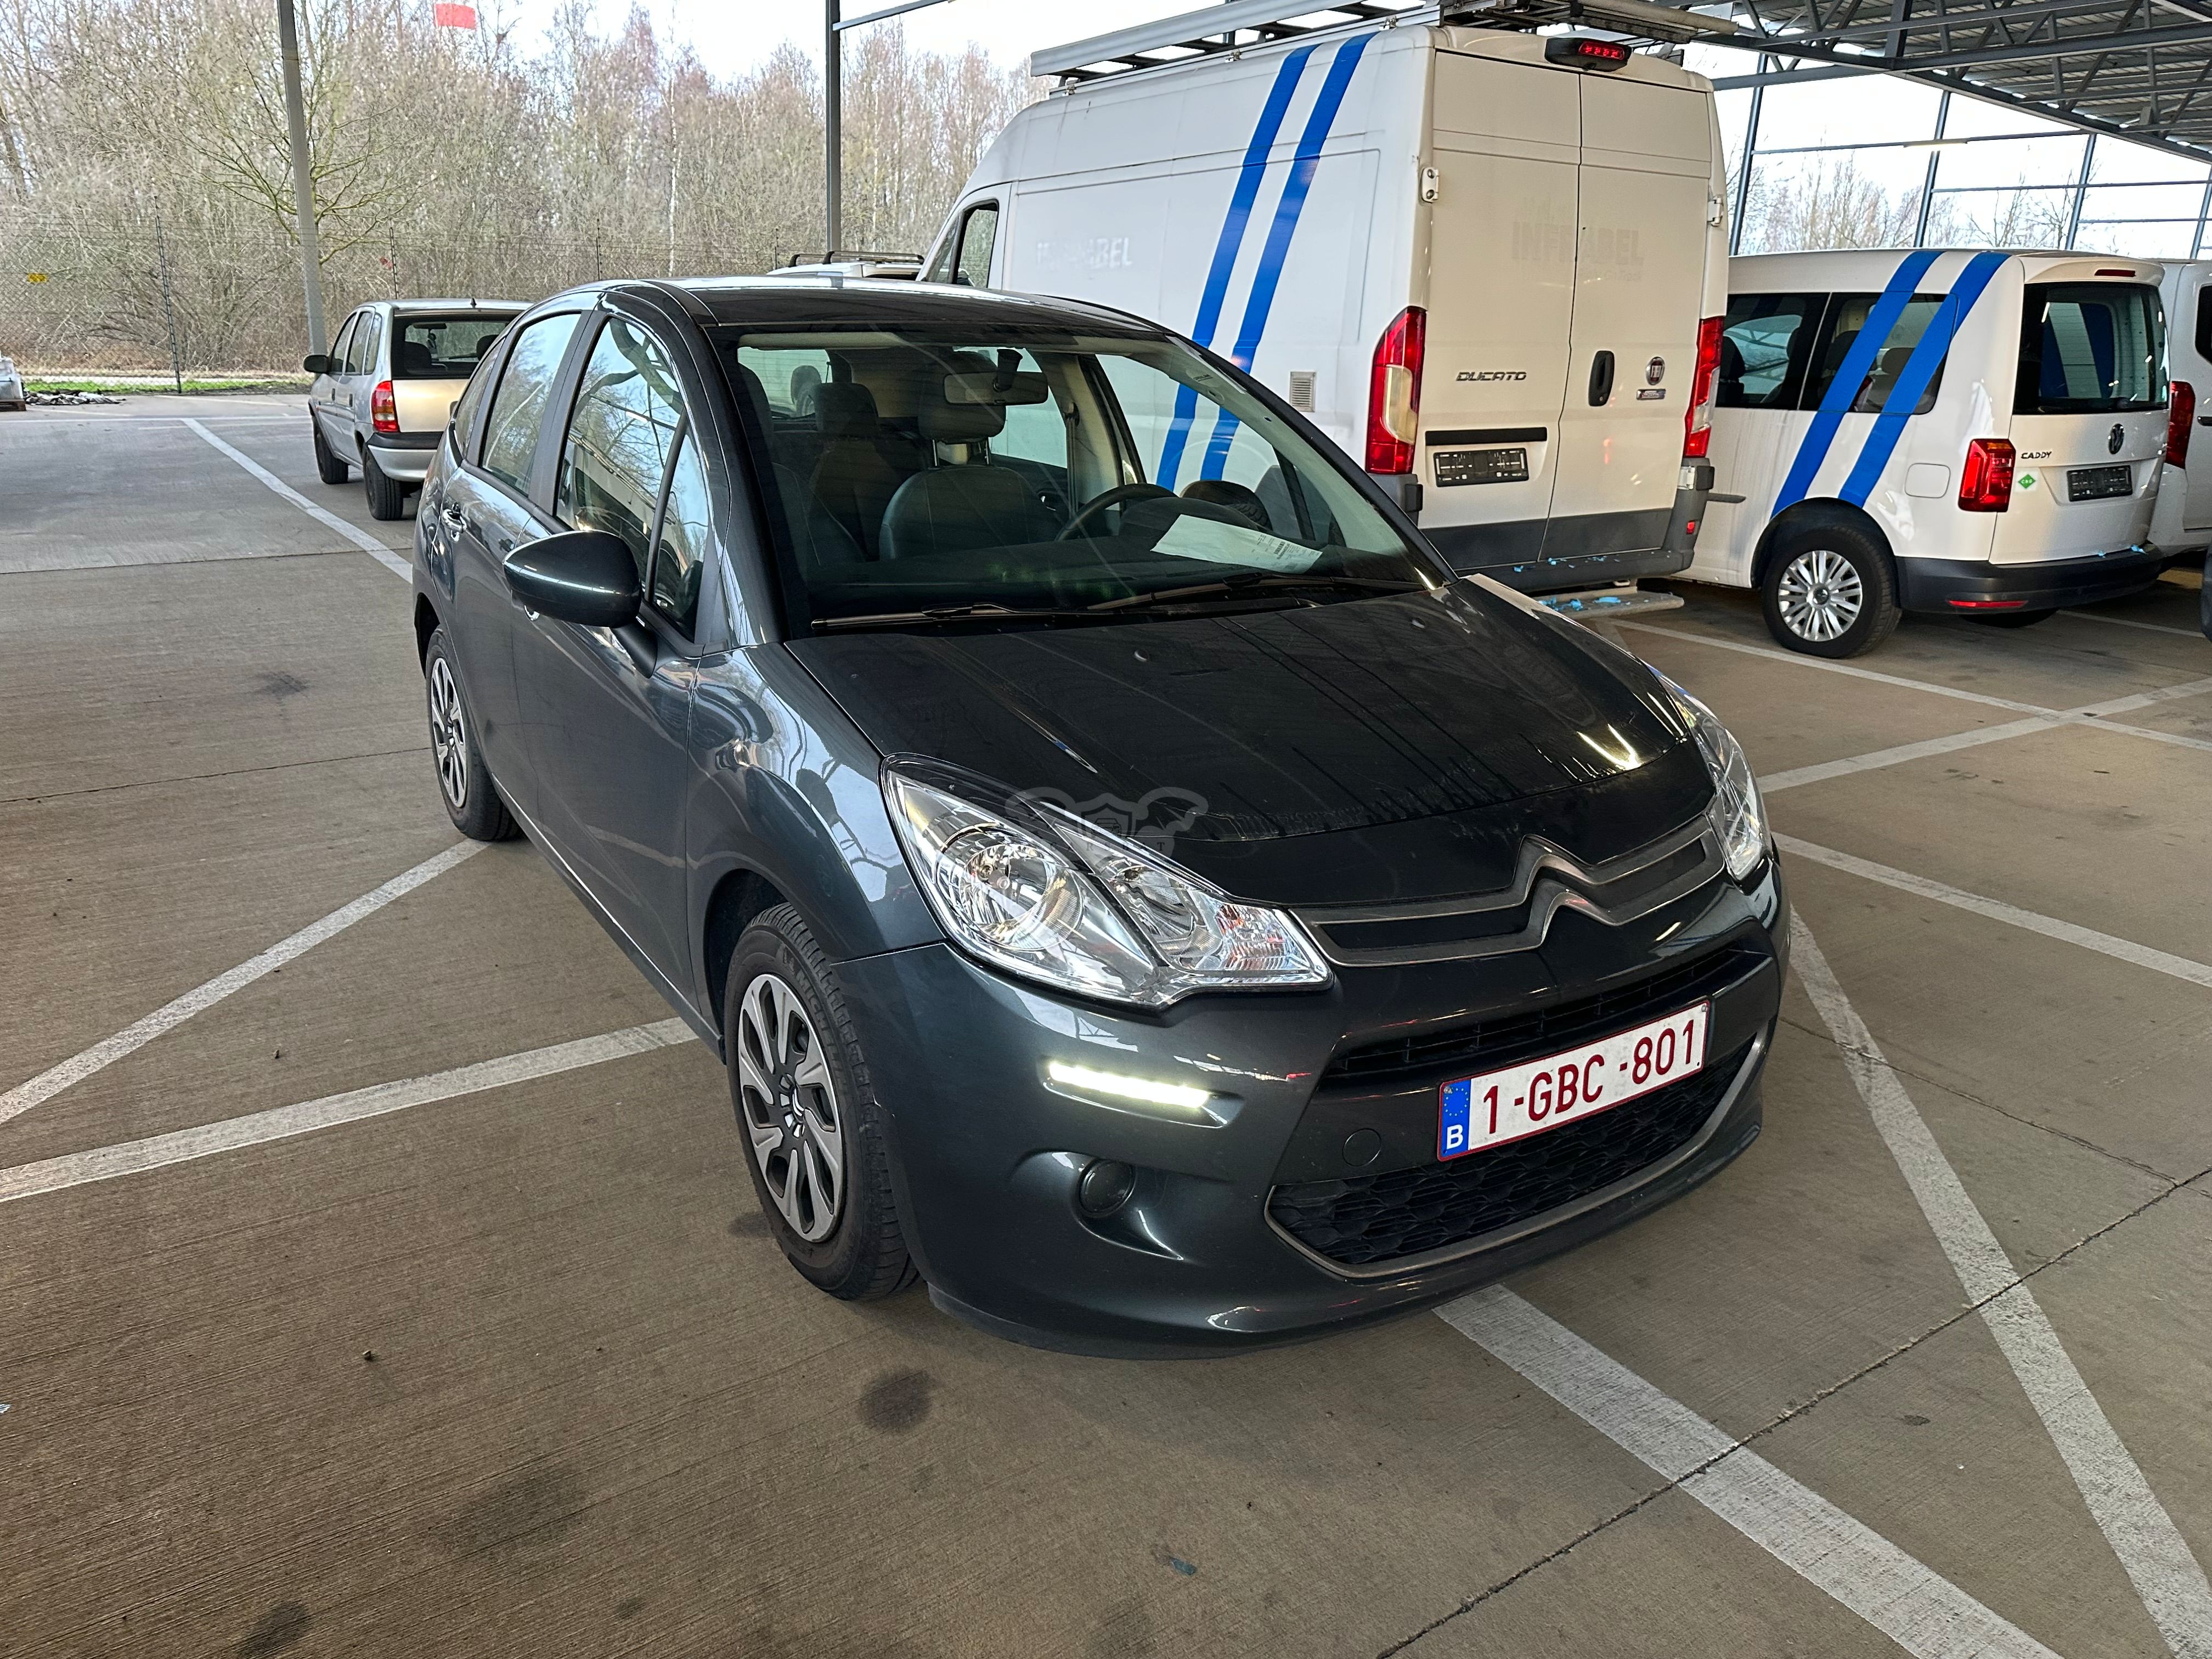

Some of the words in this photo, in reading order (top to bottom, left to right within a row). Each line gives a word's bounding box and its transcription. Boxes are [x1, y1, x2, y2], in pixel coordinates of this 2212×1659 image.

[1456, 372, 1527, 381] DUCATO
[2021, 451, 2052, 459] CADDY
[1446, 1124, 1464, 1149] B
